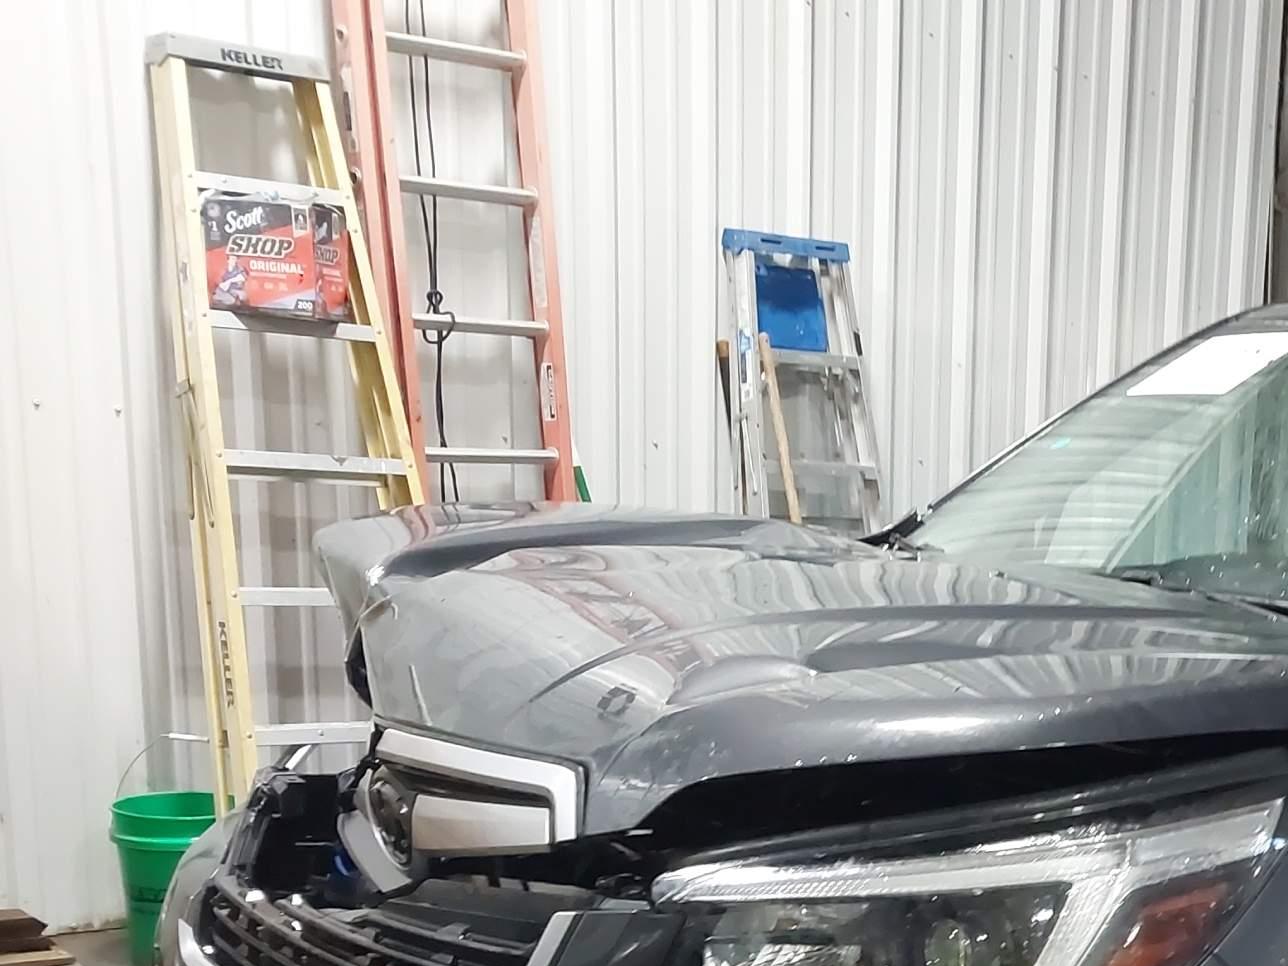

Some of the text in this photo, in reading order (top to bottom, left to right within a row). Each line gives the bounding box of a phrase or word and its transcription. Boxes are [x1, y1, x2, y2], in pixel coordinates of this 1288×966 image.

[220, 48, 283, 71] KELLER
[224, 206, 263, 233] Scott
[226, 234, 294, 258] SHOP
[249, 260, 304, 274] ORIGINAL
[297, 301, 313, 310] 200
[218, 621, 234, 708] KELLER
